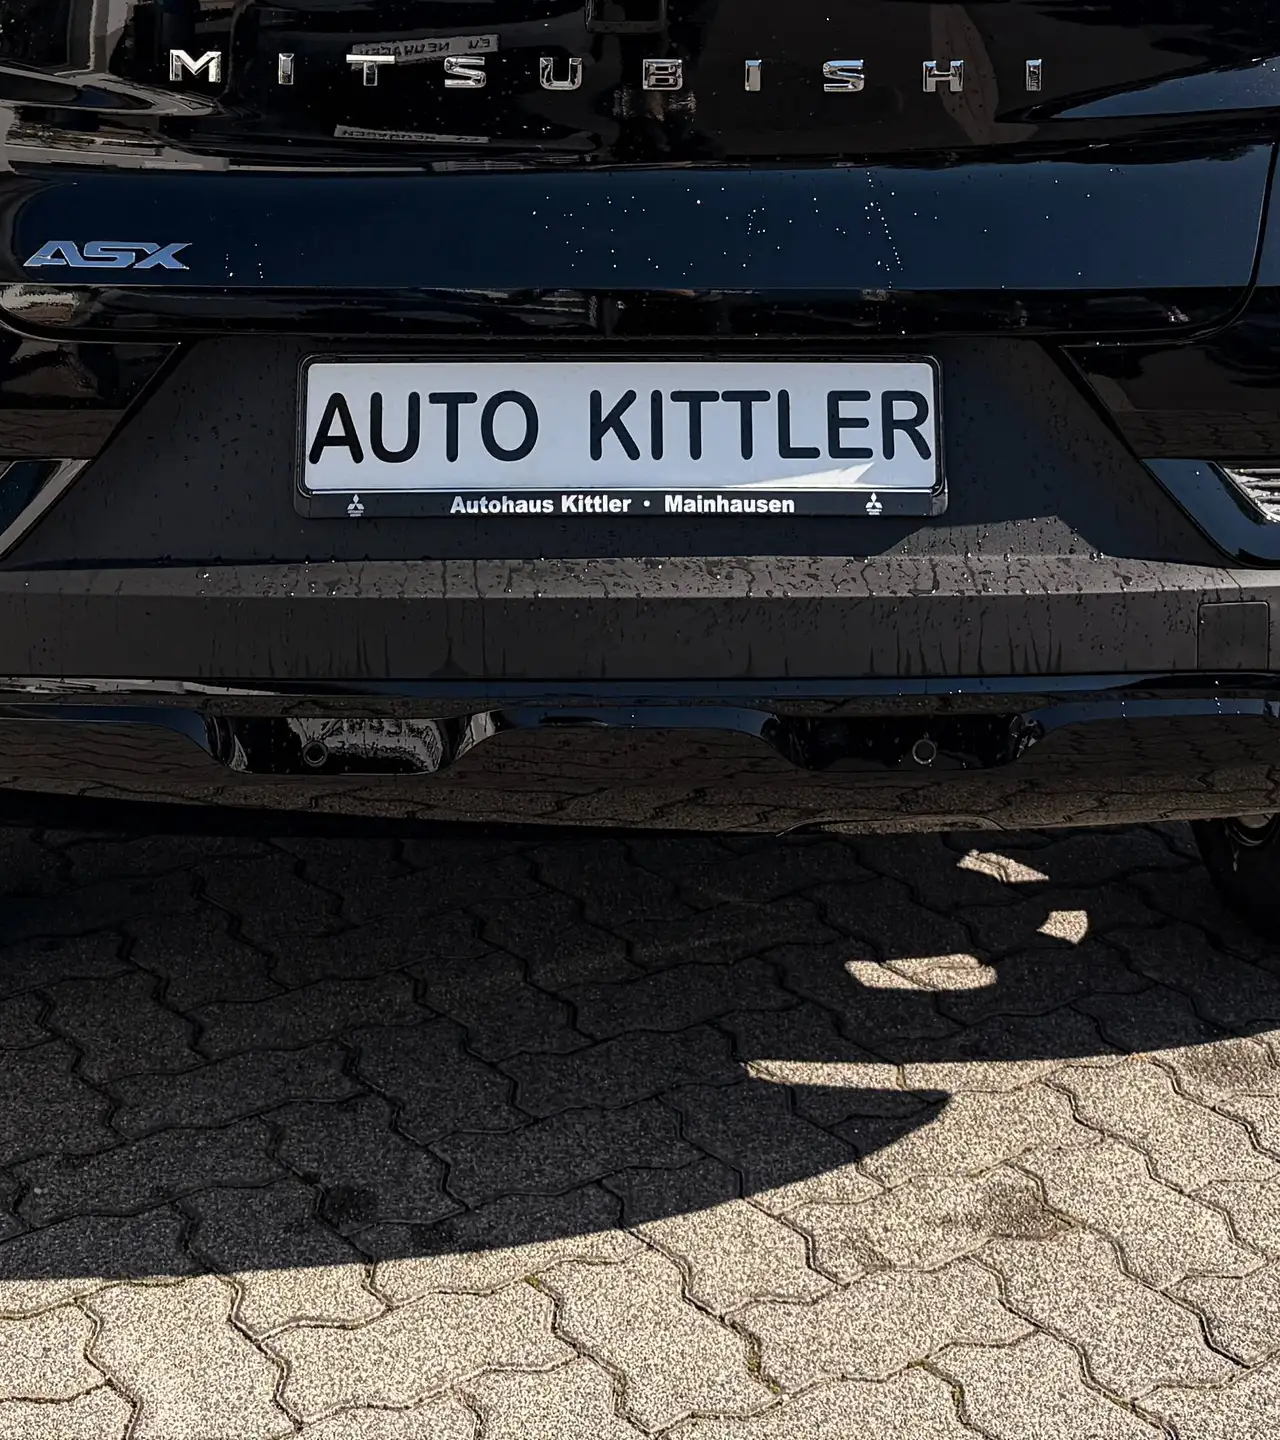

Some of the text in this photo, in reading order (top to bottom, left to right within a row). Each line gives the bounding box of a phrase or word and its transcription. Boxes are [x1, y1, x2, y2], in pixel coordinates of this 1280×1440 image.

[169, 49, 1042, 92] MITSUBISHI
[23, 241, 193, 270] ASX
[308, 388, 933, 465] AUTO KITTLER
[450, 493, 795, 515] Autohaus Kittler Mainhausen
